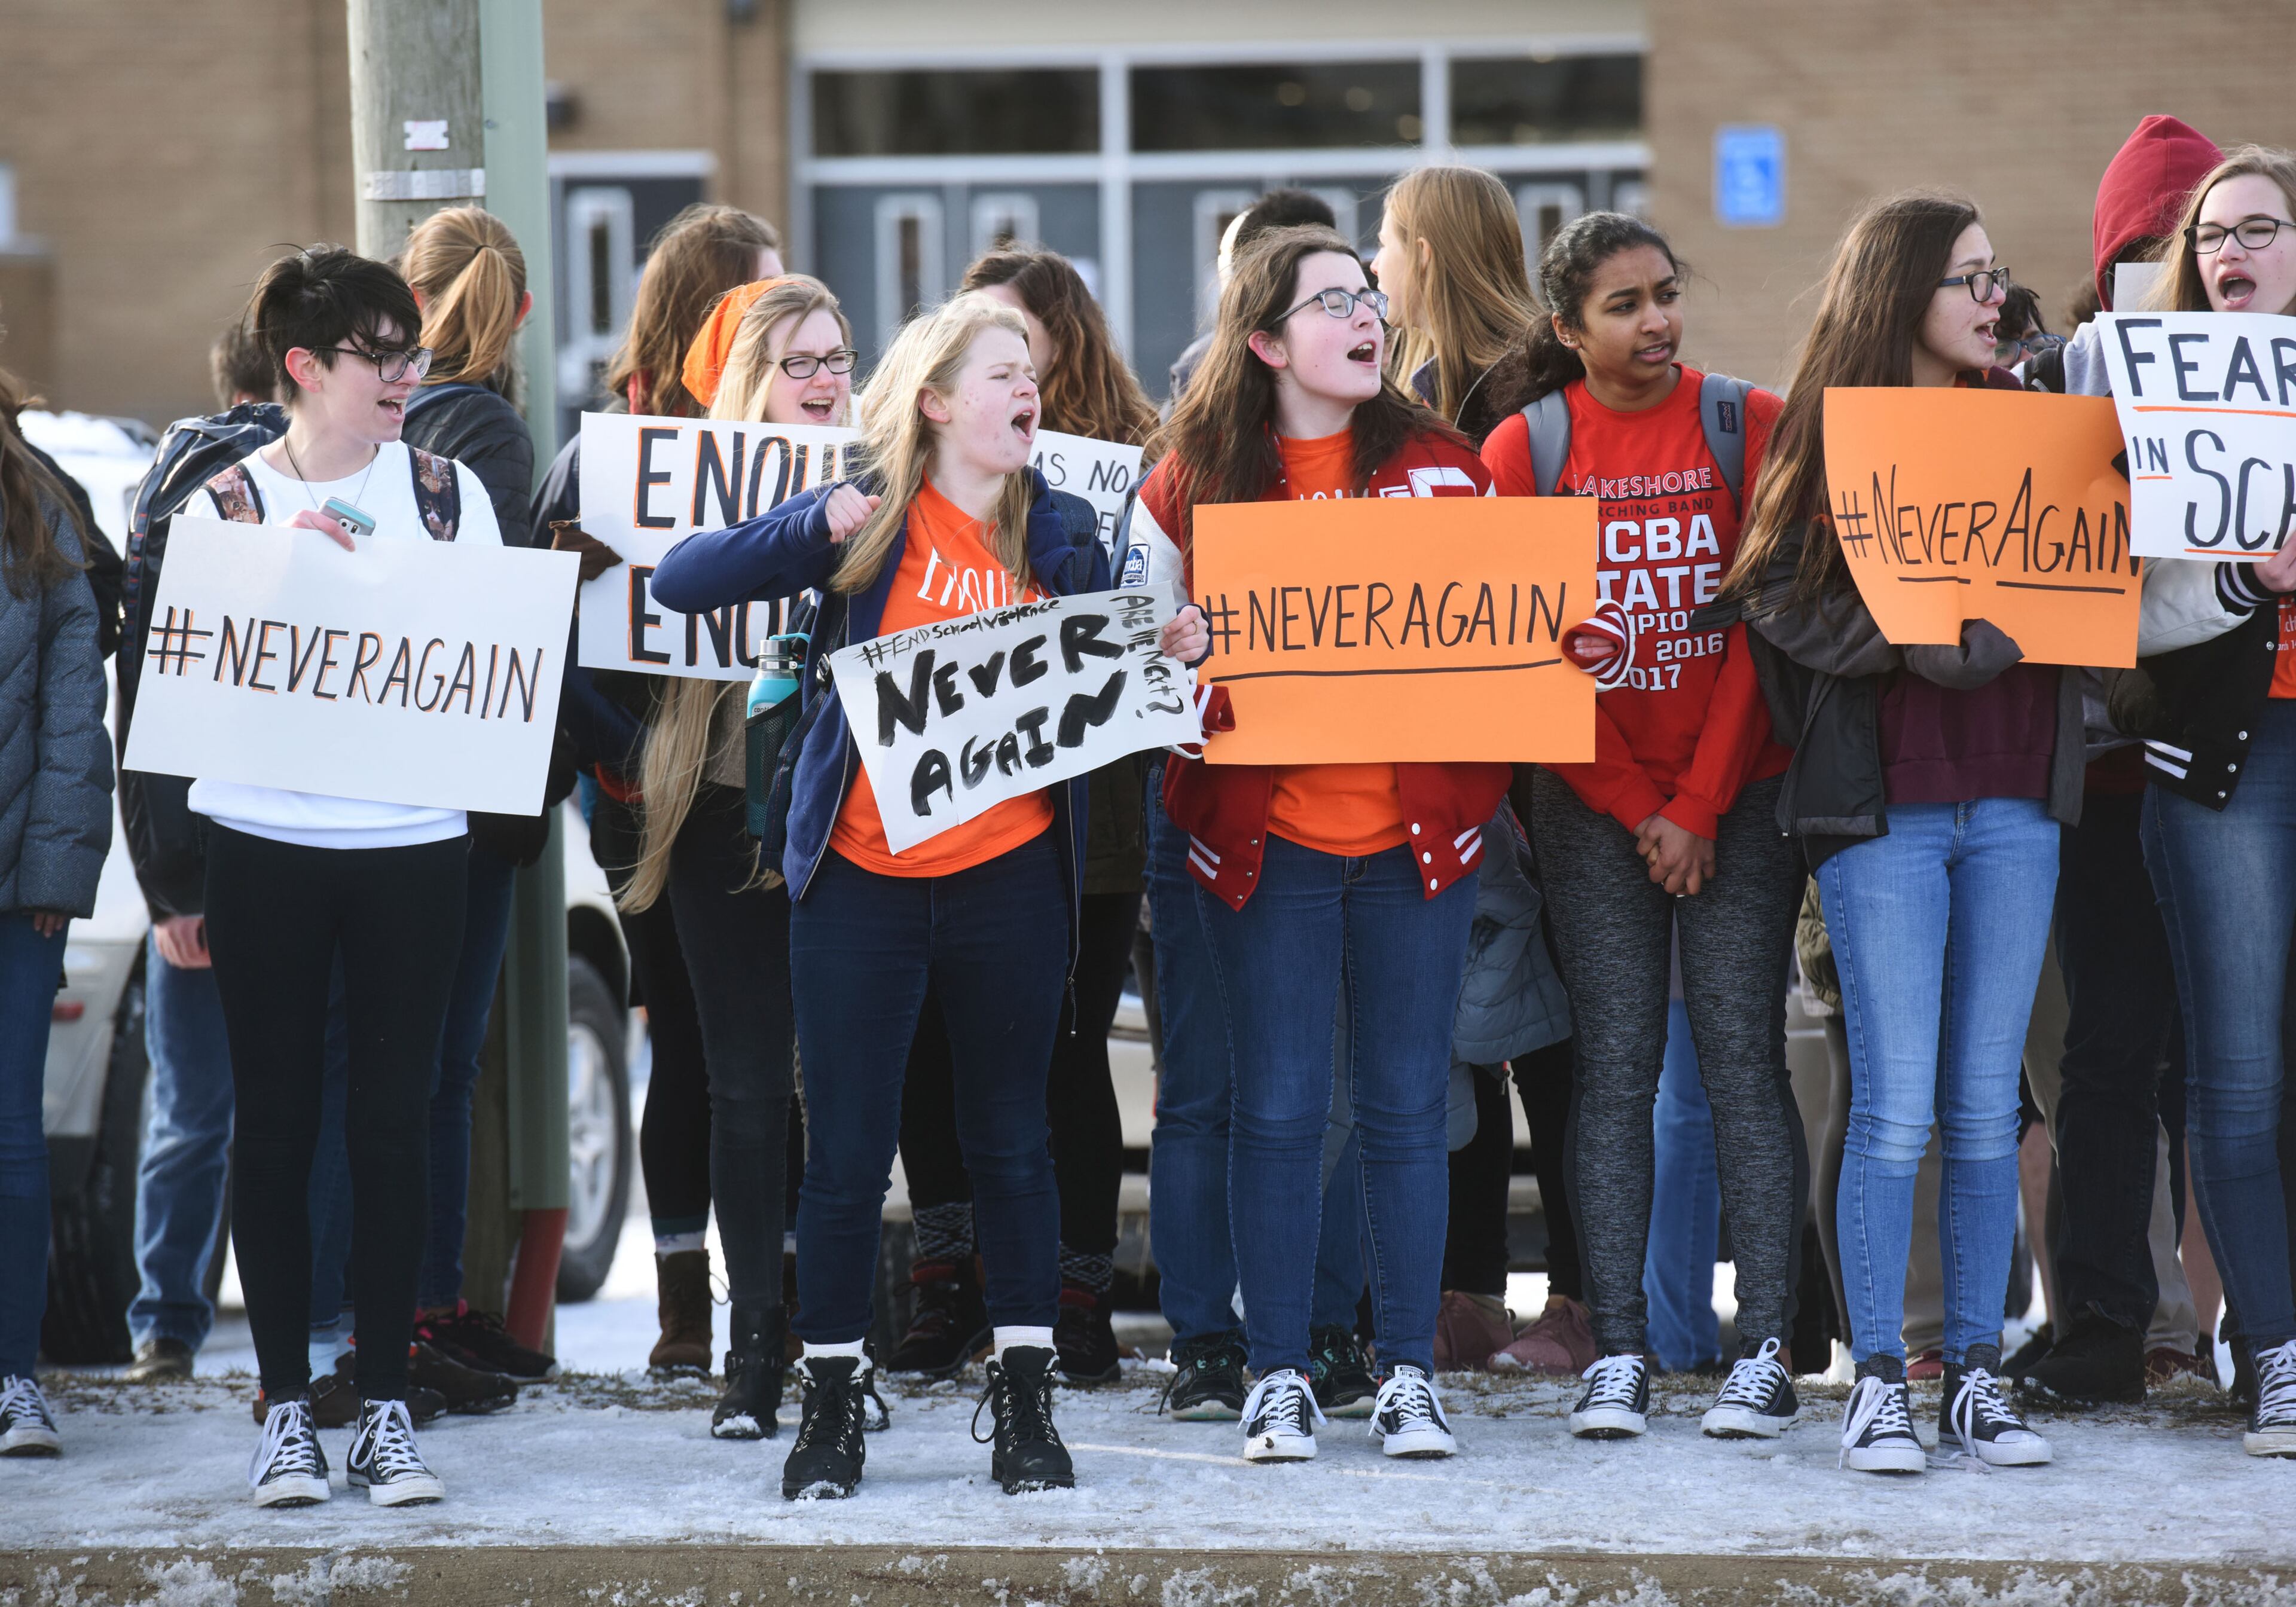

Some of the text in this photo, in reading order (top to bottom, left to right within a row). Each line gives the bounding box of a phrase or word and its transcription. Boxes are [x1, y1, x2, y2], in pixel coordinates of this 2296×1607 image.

[2132, 435, 2170, 473] IN
[1088, 459, 1129, 493] NO
[1573, 467, 1712, 499] LAKESHORE
[1668, 497, 1714, 514] BAND
[1596, 514, 1721, 563] CBA
[1596, 562, 1721, 612] TATE
[1109, 595, 1155, 629] ARE
[1205, 581, 1567, 656] #NEVERAGAIN
[1127, 627, 1160, 653] WE
[1656, 632, 1724, 662] 2016
[147, 605, 544, 723] #NEVERAGAIN
[874, 614, 1126, 747] NEVER
[1614, 663, 1681, 691] 017
[910, 668, 1128, 817] AGAIN
